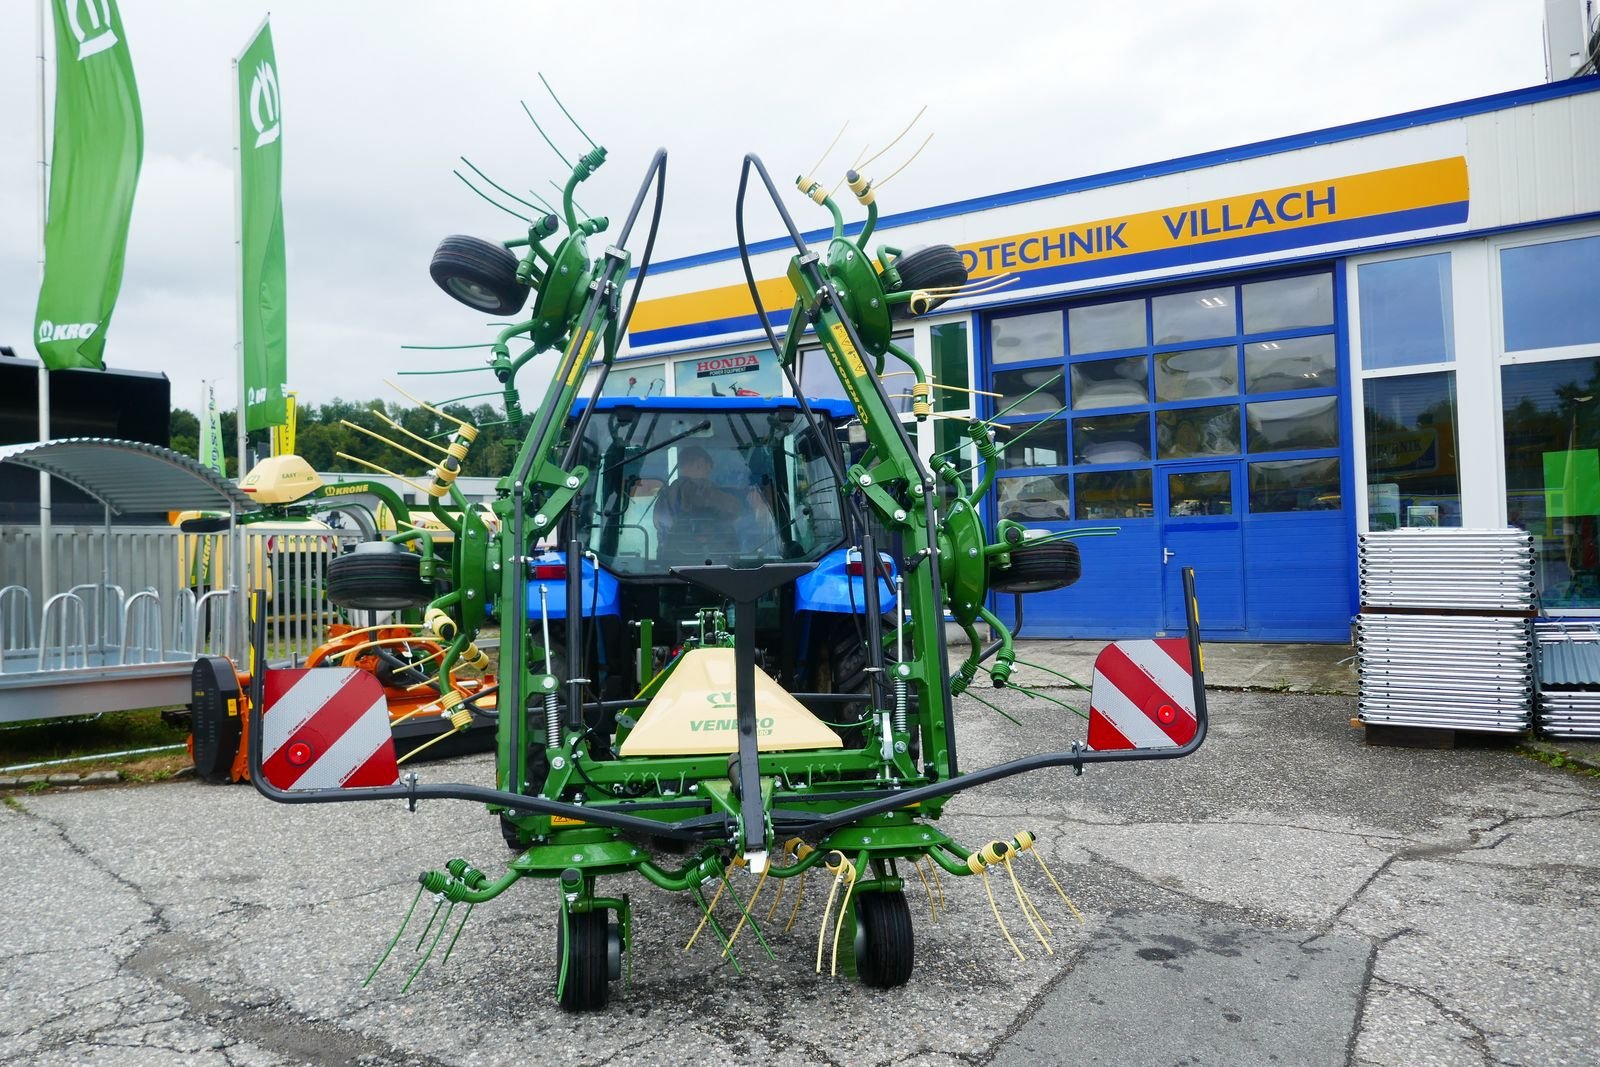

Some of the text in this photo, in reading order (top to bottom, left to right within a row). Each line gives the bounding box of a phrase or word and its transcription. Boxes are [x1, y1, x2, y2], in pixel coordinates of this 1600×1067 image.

[1162, 186, 1336, 240] VILLACH
[53, 322, 99, 341] KRO
[697, 355, 759, 371] HONDA
[724, 367, 747, 376] EQUIPMENT
[826, 342, 860, 403] KRONE
[335, 484, 369, 496] KRONE
[690, 717, 774, 731] VENO
